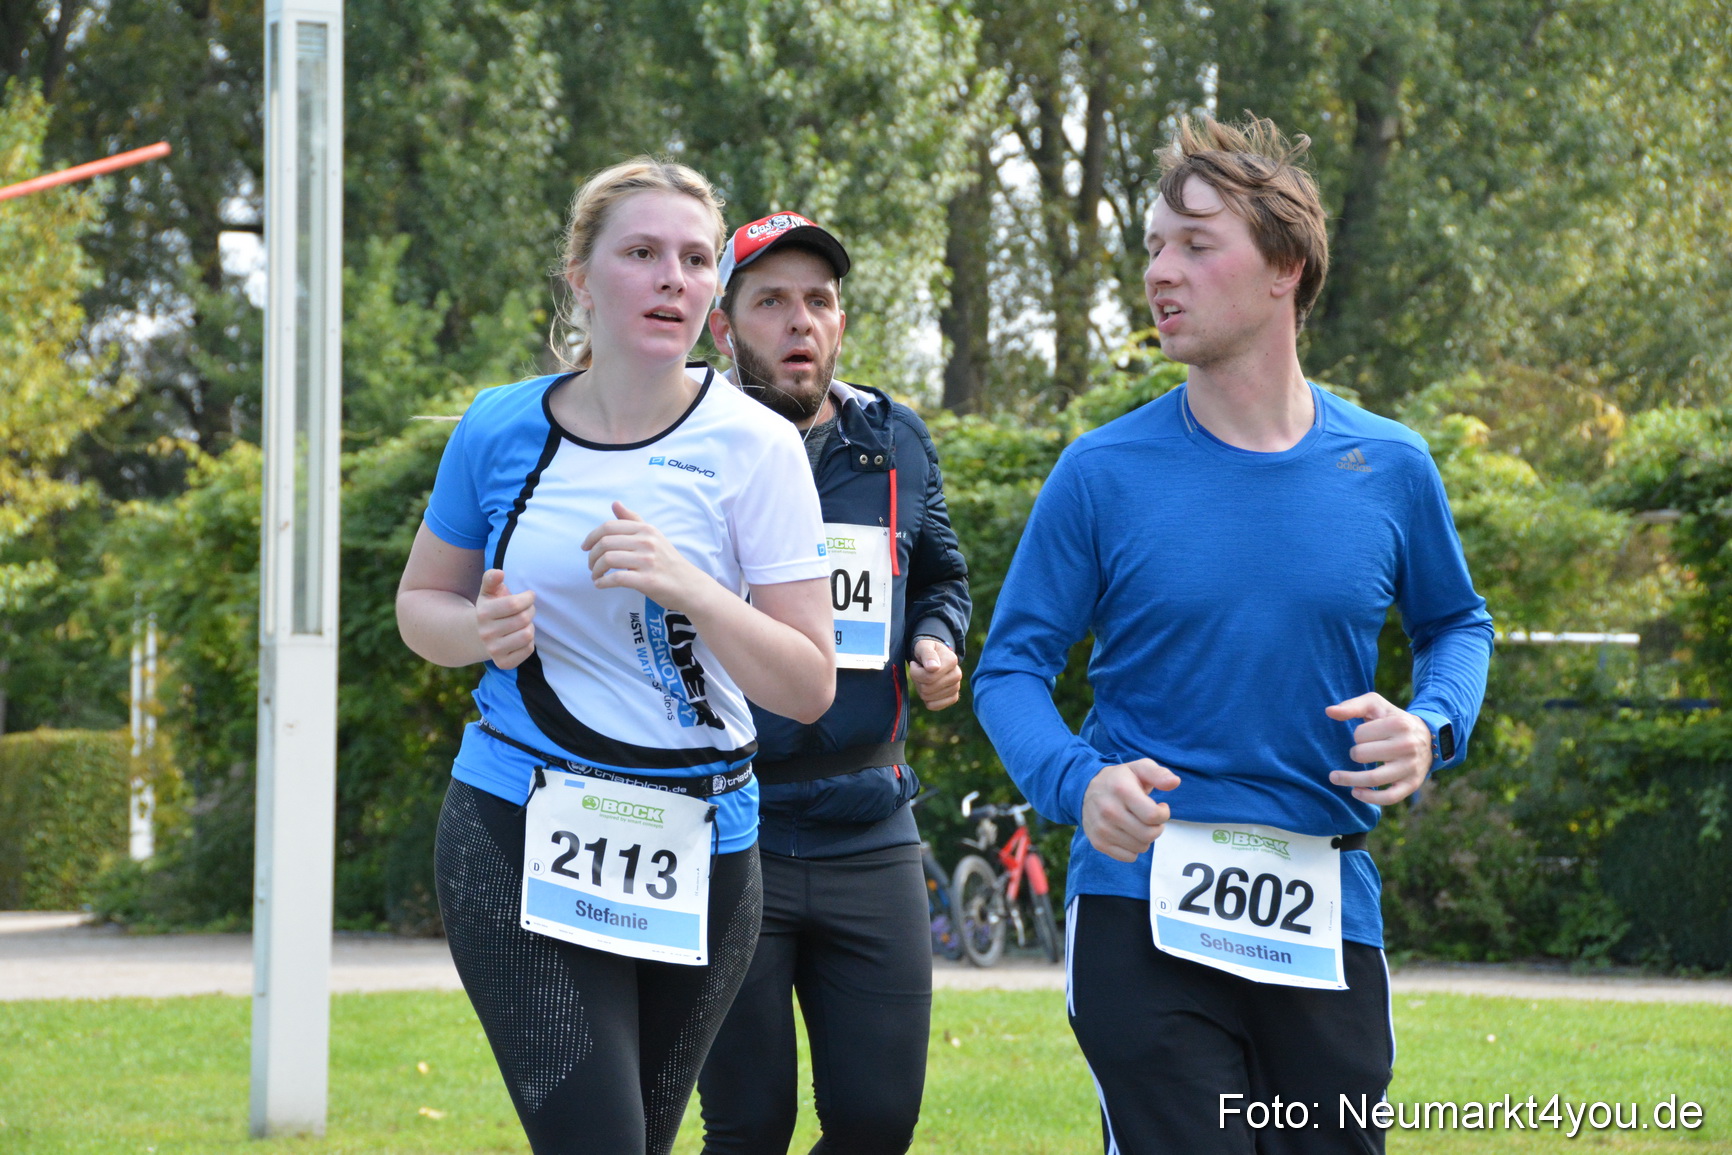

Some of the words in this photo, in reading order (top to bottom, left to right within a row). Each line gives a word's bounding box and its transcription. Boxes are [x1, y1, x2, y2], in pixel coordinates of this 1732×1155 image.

[1336, 462, 1373, 473] adidas
[826, 537, 856, 550] OCK
[830, 568, 873, 612] 04
[601, 798, 665, 823] BOCK
[1232, 831, 1290, 855] BOCK
[533, 862, 540, 872] D
[550, 830, 678, 901] 2113
[1160, 901, 1167, 910] D
[1178, 862, 1315, 935] 2602
[575, 899, 649, 931] Stefanie
[1199, 932, 1293, 964] Sebastian
